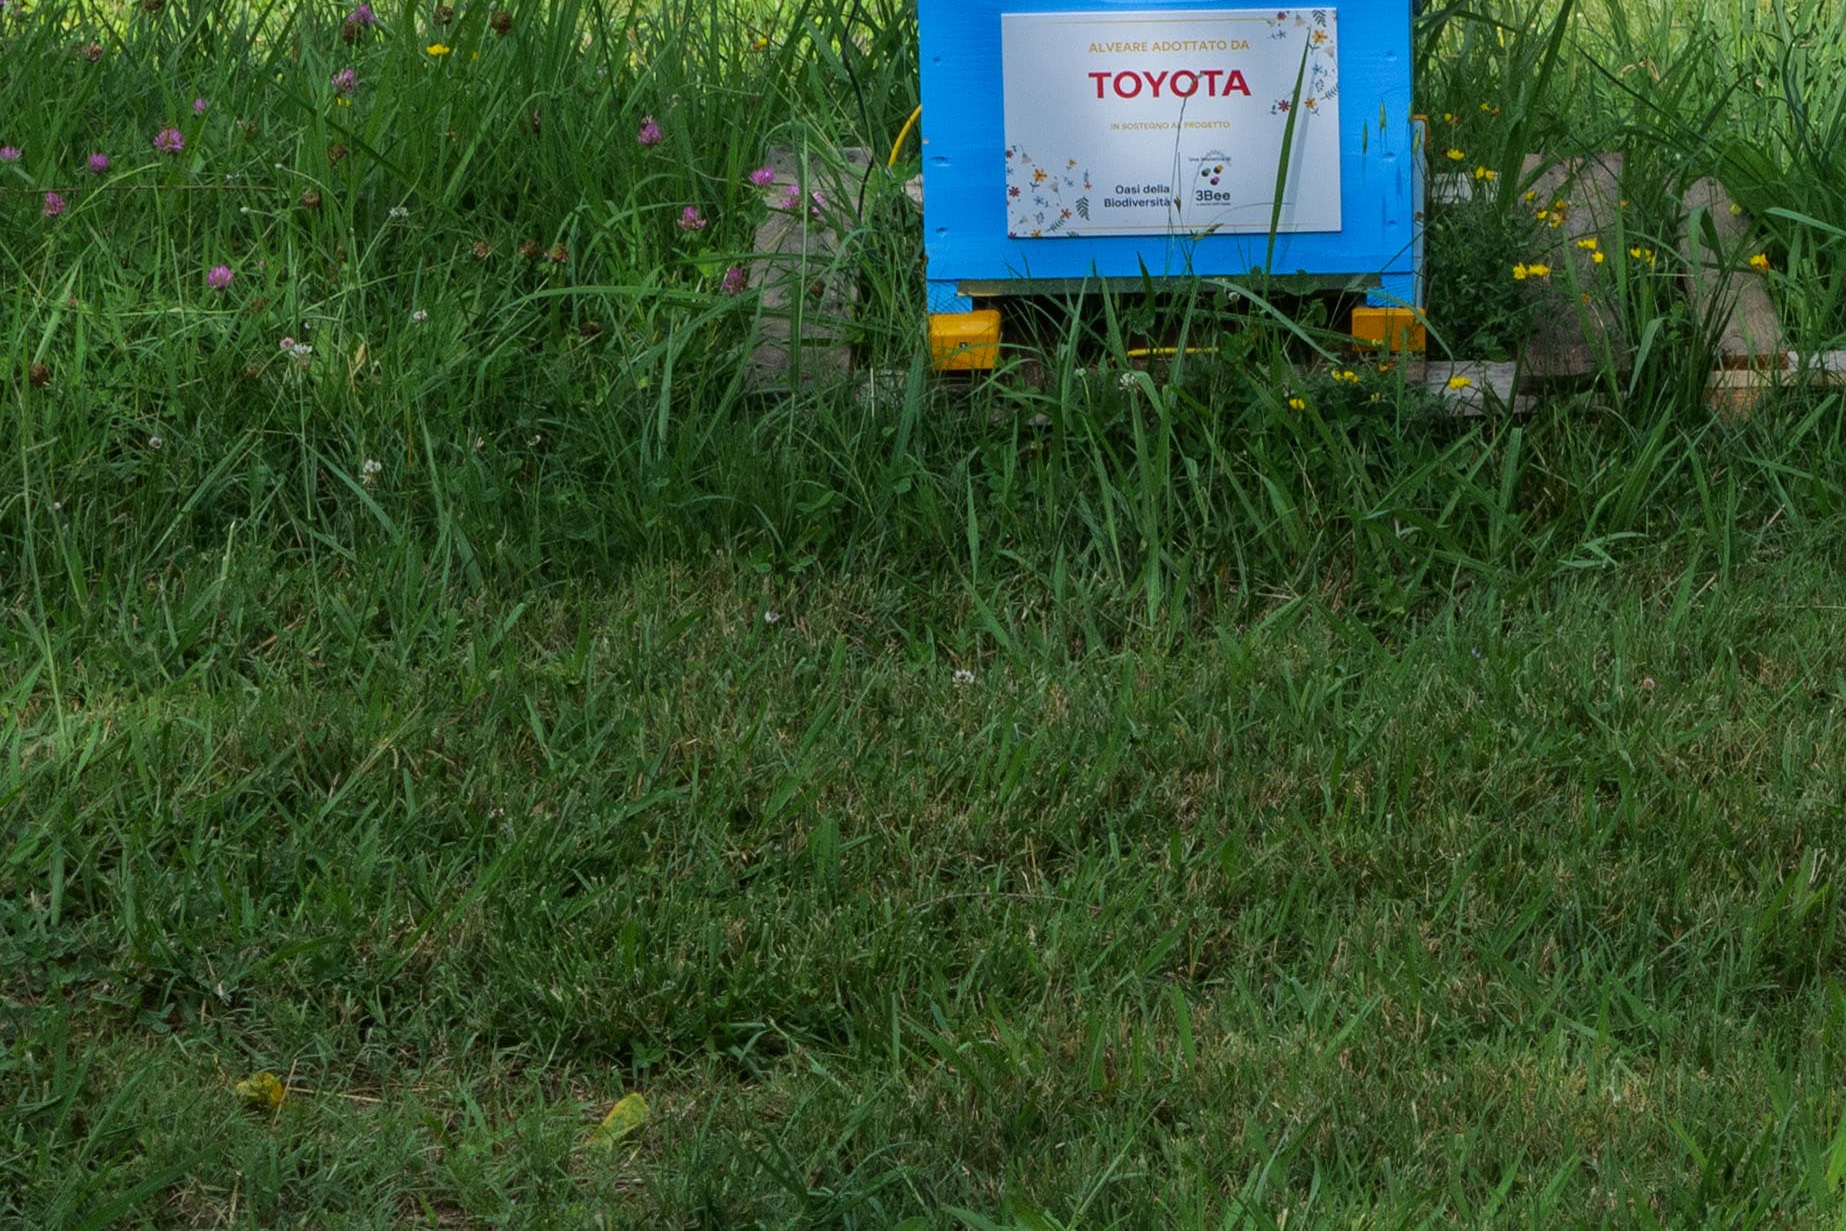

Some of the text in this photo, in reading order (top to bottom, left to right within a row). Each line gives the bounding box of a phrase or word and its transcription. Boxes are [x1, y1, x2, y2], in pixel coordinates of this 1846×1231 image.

[1088, 40, 1250, 53] ALVEARE ADOTTATO DA
[1088, 70, 1252, 99] TOYOTA
[1115, 184, 1170, 194] Oasi della
[1196, 190, 1231, 202] 3Bee
[1104, 198, 1170, 208] Biodiversità
